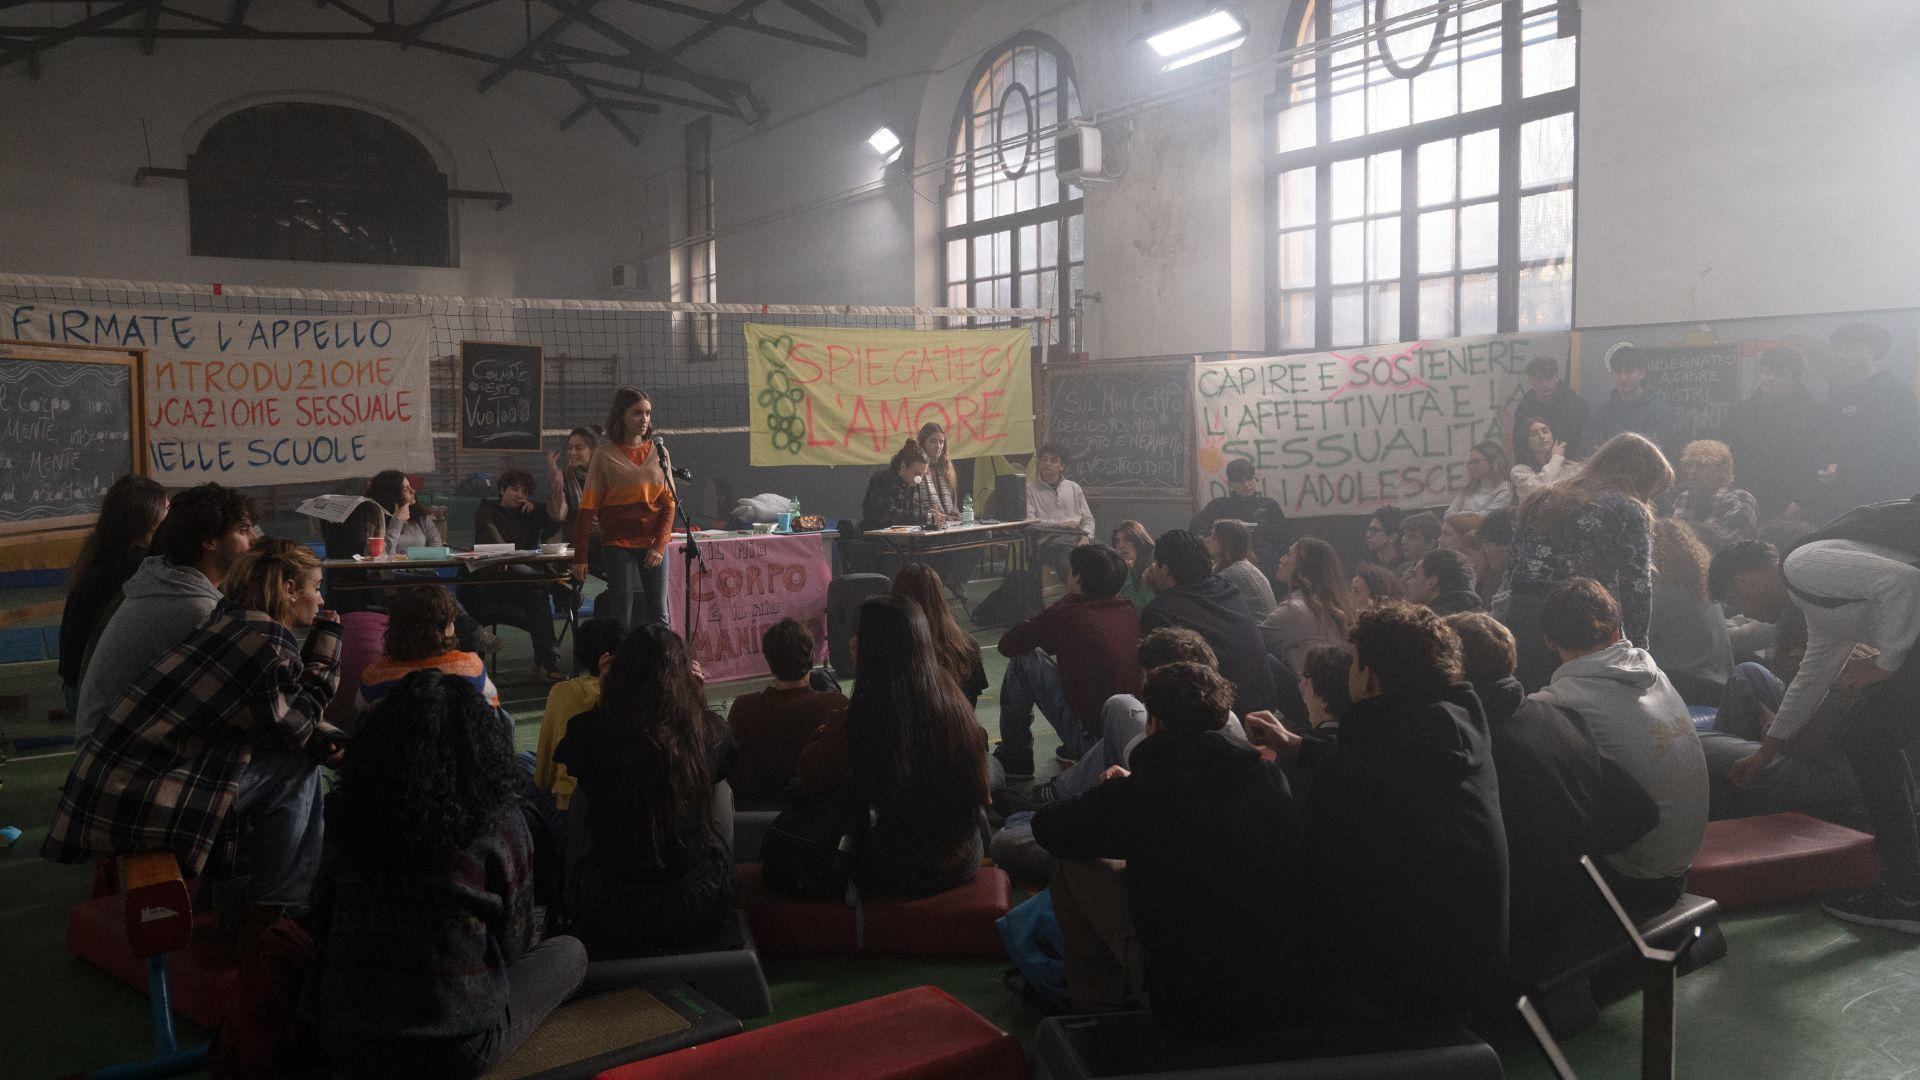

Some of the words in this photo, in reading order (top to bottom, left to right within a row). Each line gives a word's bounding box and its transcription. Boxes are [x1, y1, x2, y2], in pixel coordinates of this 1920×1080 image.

[13, 306, 196, 349] FIRMATE
[218, 319, 392, 351] L'APPELLO
[155, 357, 393, 392] NTRODUZIONE
[787, 342, 1012, 391] SPIEGATECI
[1199, 362, 1308, 398] CAPIRE
[1317, 362, 1338, 391] E
[1349, 340, 1529, 386] SOSTENERE
[149, 397, 281, 428] UCAZIONE
[296, 391, 412, 426] SESSUALE
[805, 389, 1008, 453] L'AMORE
[1449, 385, 1475, 417] E
[248, 435, 367, 467] SCUOLE
[1296, 462, 1465, 512] ADOLESCE
[691, 563, 807, 601] CORPO
